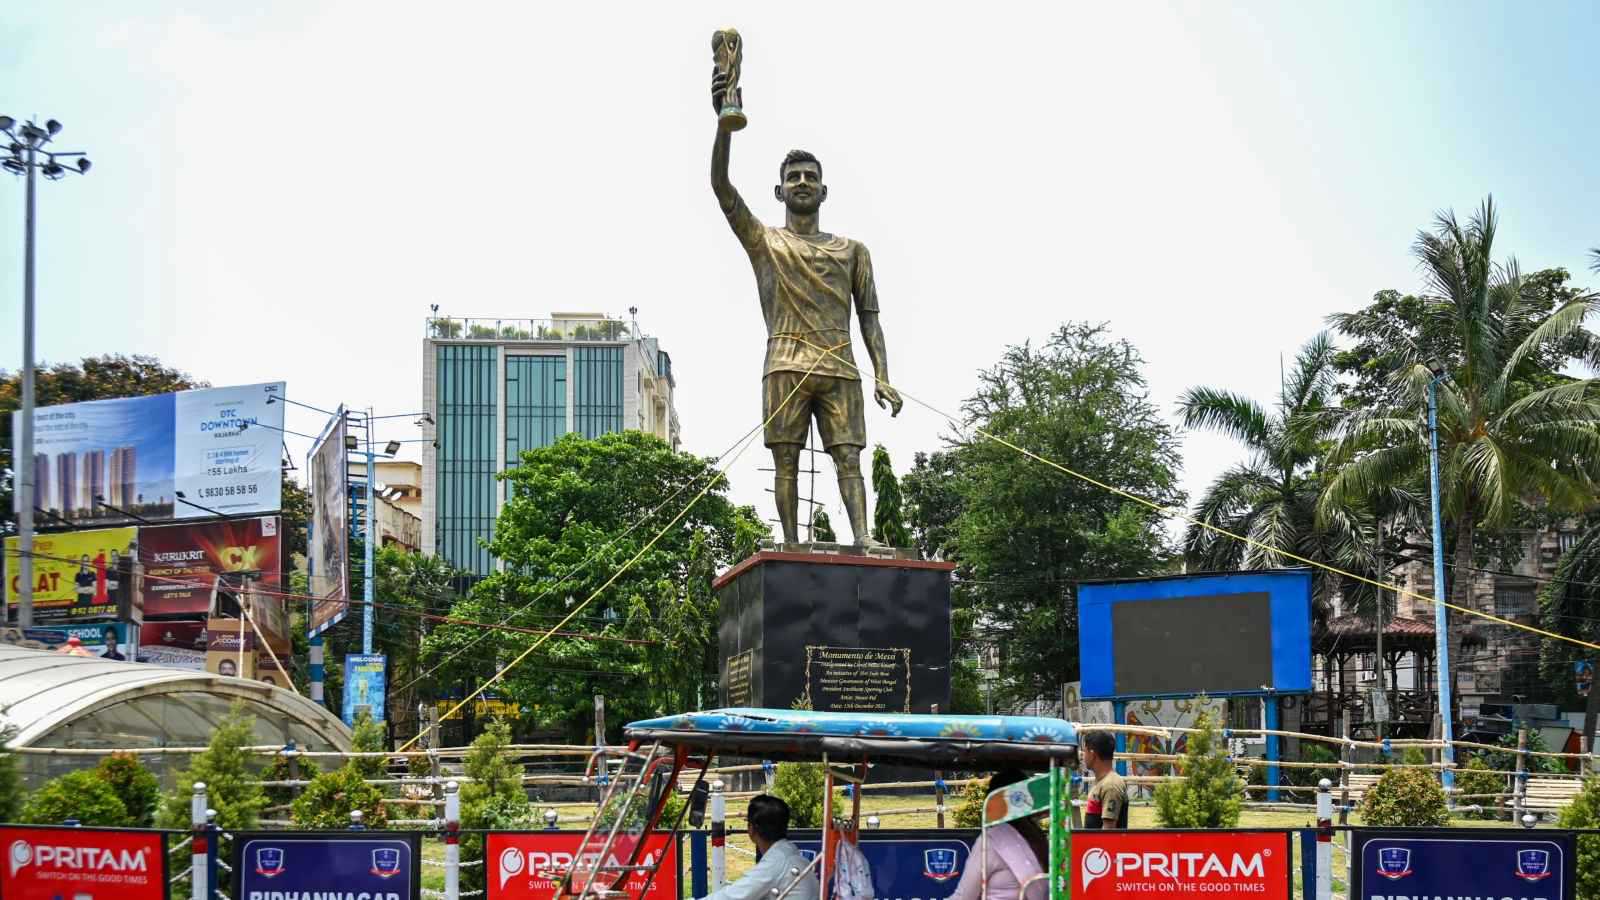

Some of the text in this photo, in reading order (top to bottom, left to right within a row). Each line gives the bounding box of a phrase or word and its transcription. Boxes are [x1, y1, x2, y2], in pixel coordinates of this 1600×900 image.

[220, 409, 237, 418] DTC
[200, 416, 258, 431] DOWNTOWN
[820, 651, 896, 660] Monumento de Messi
[34, 845, 148, 872] PRITAM
[1115, 852, 1265, 877] PRITAM
[1116, 883, 1265, 891] SWITCH ON THE GOOD TIMES
